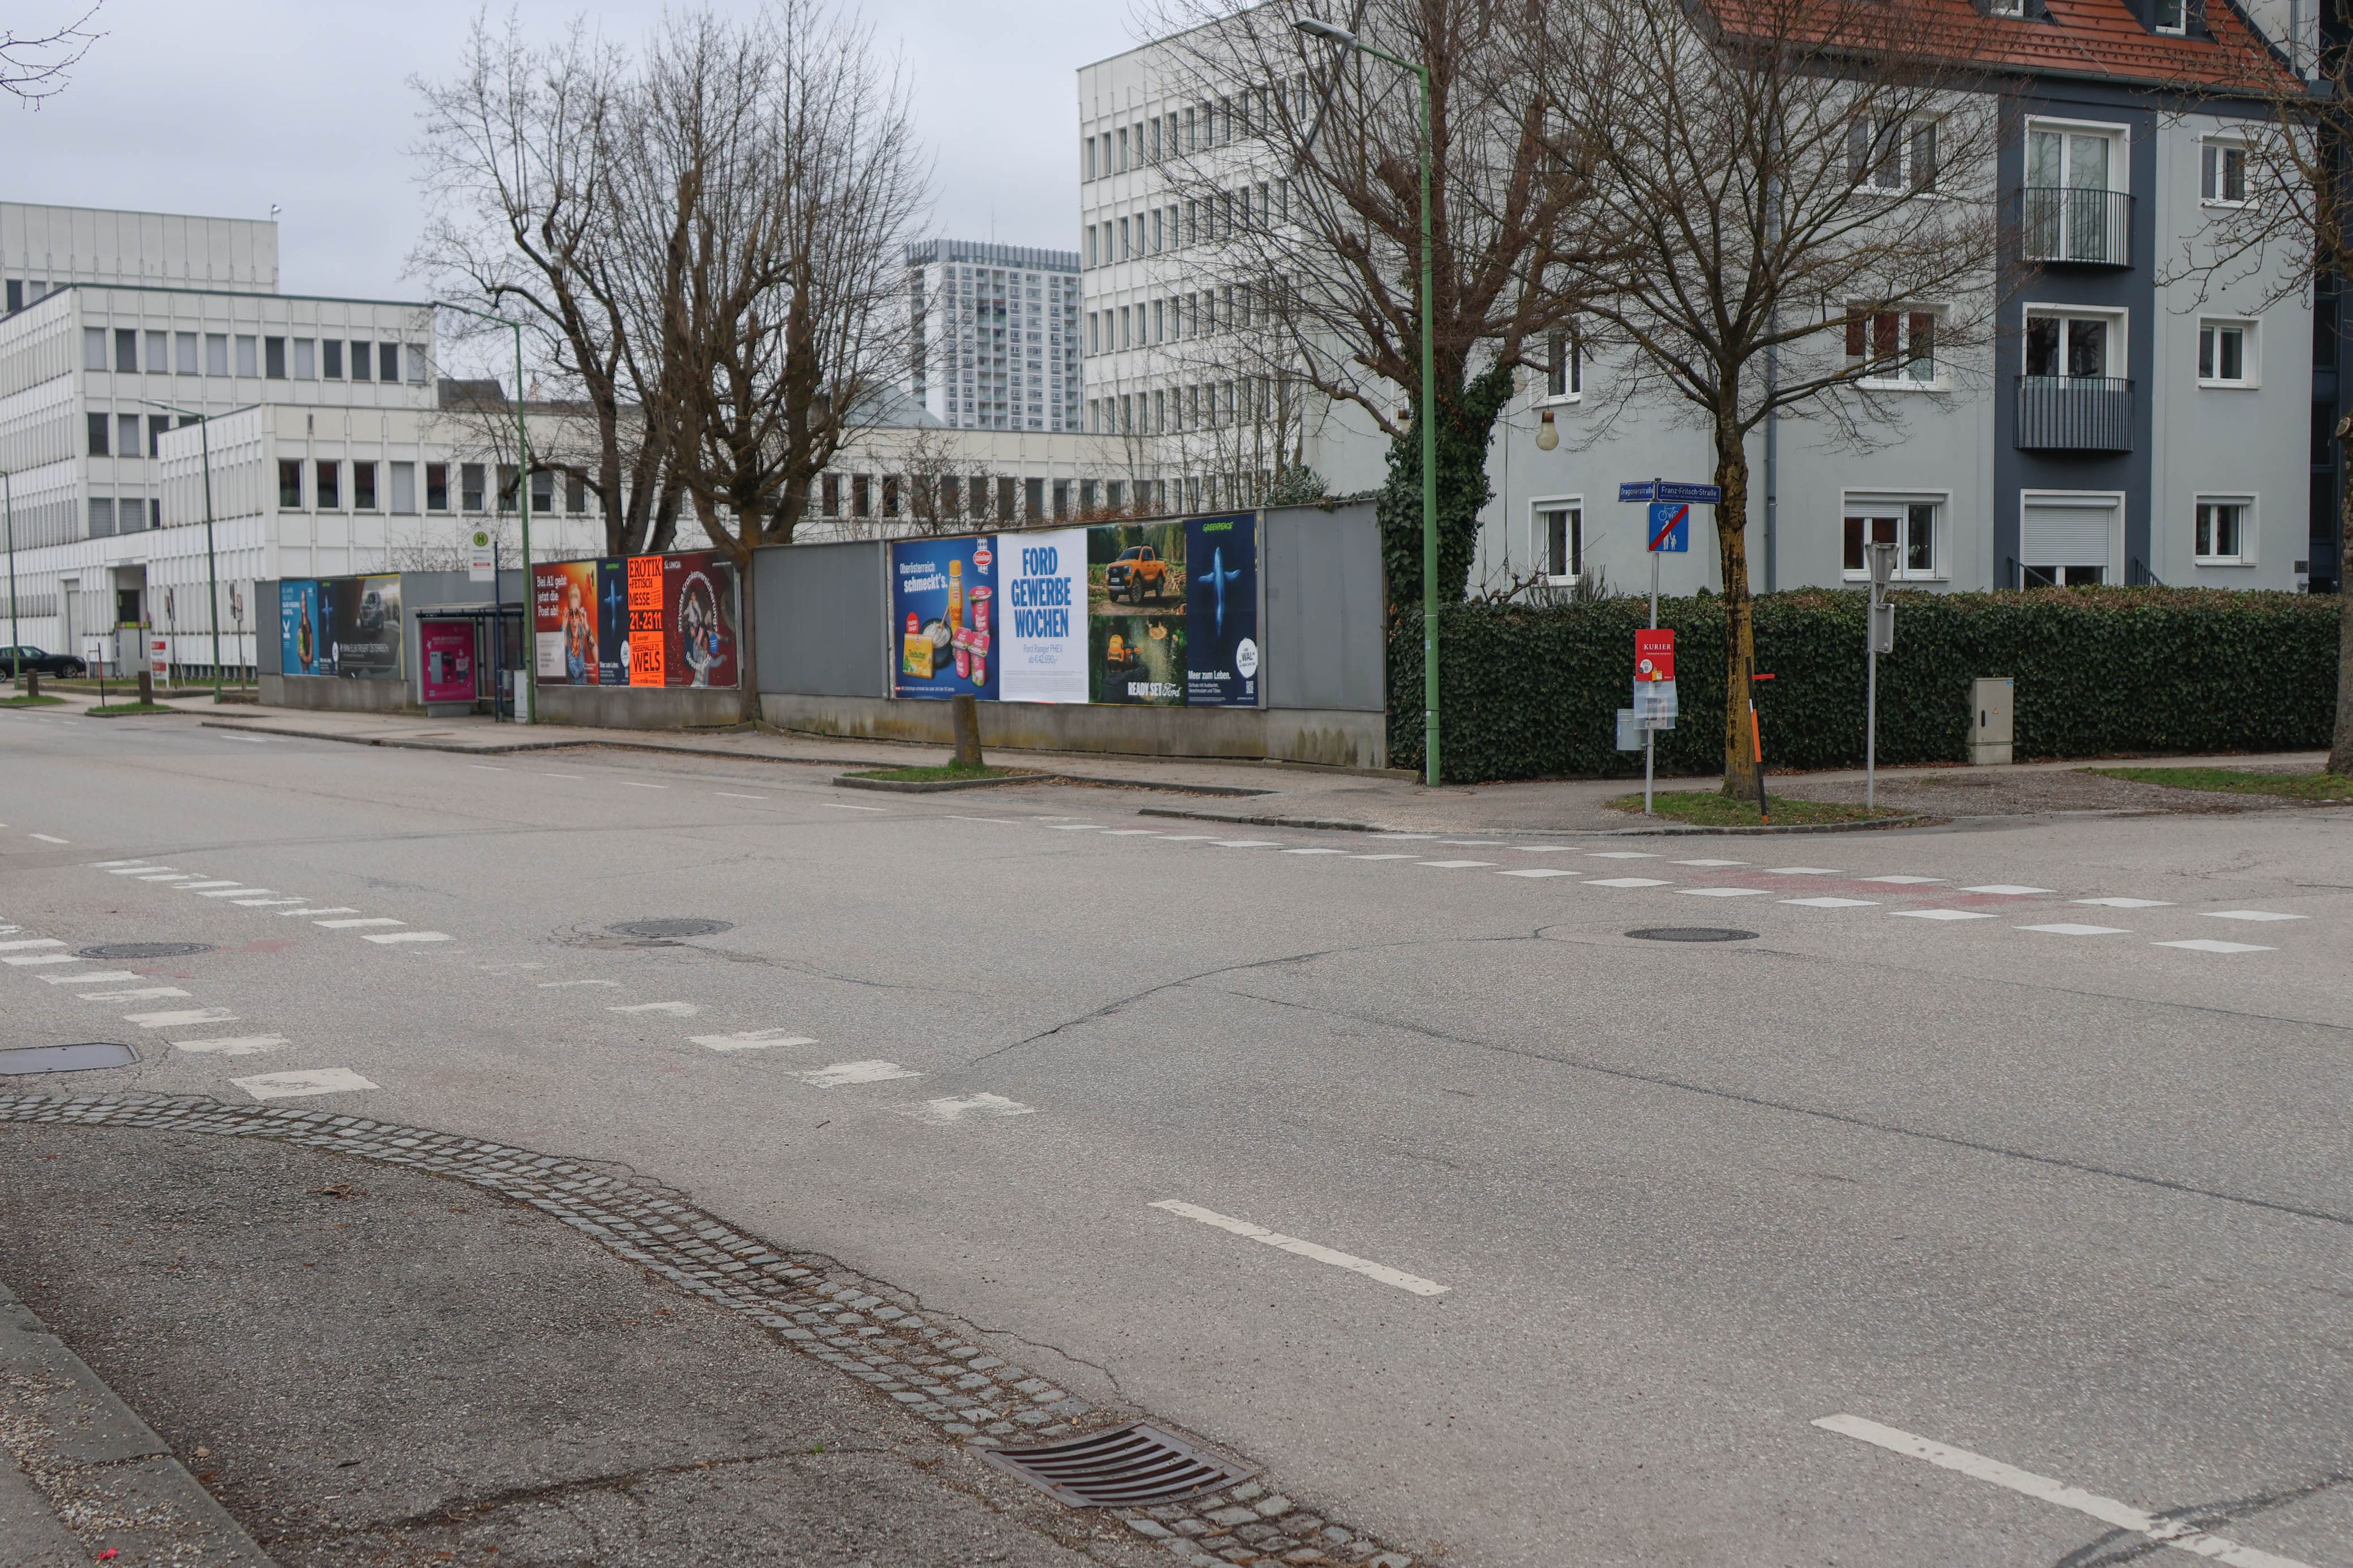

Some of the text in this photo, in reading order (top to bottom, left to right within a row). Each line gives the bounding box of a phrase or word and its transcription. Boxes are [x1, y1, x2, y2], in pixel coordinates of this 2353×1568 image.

[1621, 486, 1654, 496] Dragonerstraße
[1661, 486, 1717, 496] Franz-Fritsch-Straße
[1202, 522, 1234, 532] GREENPEACE
[899, 561, 935, 573] Oberösterreich
[1022, 546, 1058, 576] FORD
[629, 559, 661, 578] EROTIK
[536, 575, 567, 588] Bei A1 geht
[629, 578, 652, 588] +FETISCH
[537, 590, 559, 604] jetzt die
[1011, 577, 1071, 607] GEWERBE
[629, 592, 650, 606] MESSE
[538, 605, 558, 616] Post ab!
[1014, 608, 1068, 638] WOCHEN
[1024, 644, 1063, 654] Ford Ranger PHEV
[633, 651, 660, 672] WELS
[1188, 670, 1231, 680] Meer zum Leben.
[1128, 682, 1182, 697] READY SET Ford
